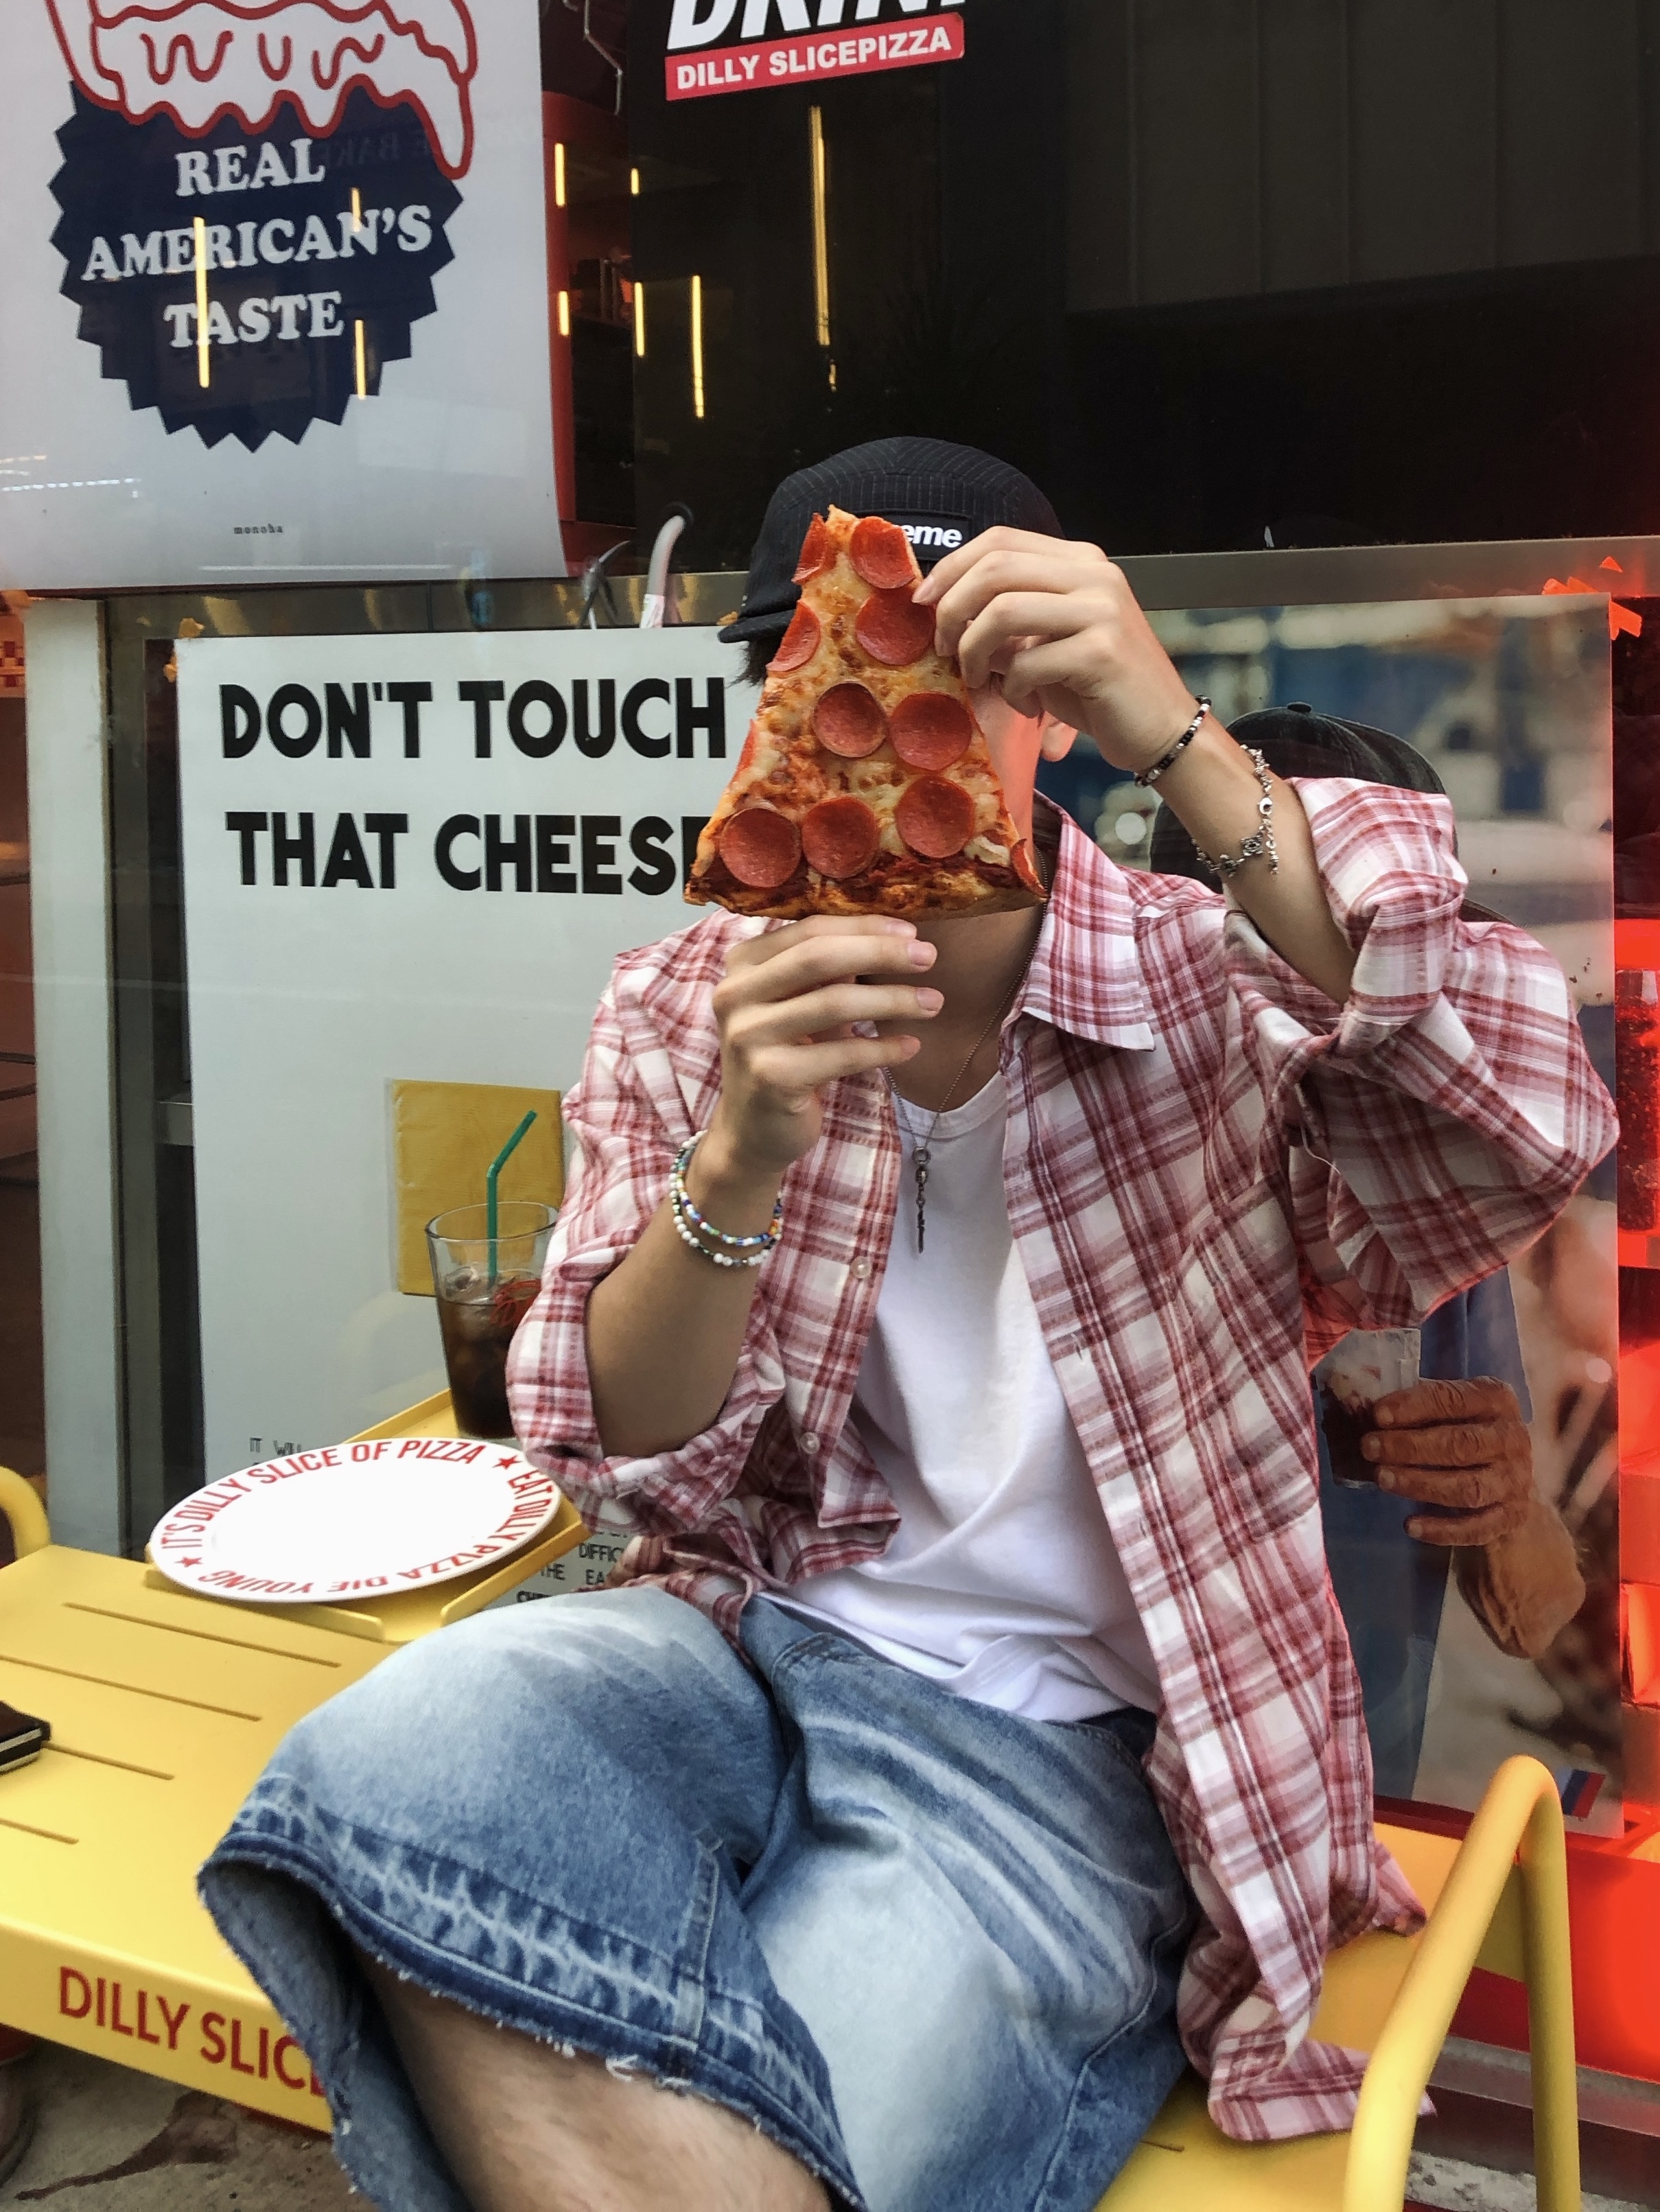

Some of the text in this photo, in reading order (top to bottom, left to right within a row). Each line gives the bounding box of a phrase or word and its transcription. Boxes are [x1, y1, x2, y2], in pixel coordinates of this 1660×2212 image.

[677, 26, 951, 90] DILLY SLICEPIZZA
[174, 138, 325, 197] REAL
[81, 205, 433, 281] AMERICAN'S
[164, 291, 344, 348] TASTE
[900, 524, 962, 548] eme
[220, 677, 726, 758] DON'T TOUCH
[225, 812, 408, 889] THAT
[250, 1438, 262, 1452] IT
[161, 1441, 487, 1549] IT'S DILLY SLICE OF PIZZA
[198, 1469, 553, 1594] EAT DILLY PIZZA DIE YOUNG
[578, 1543, 624, 1562] DIFFIC
[585, 1568, 605, 1585] EA
[60, 1966, 325, 2097] DILLY SLIC
